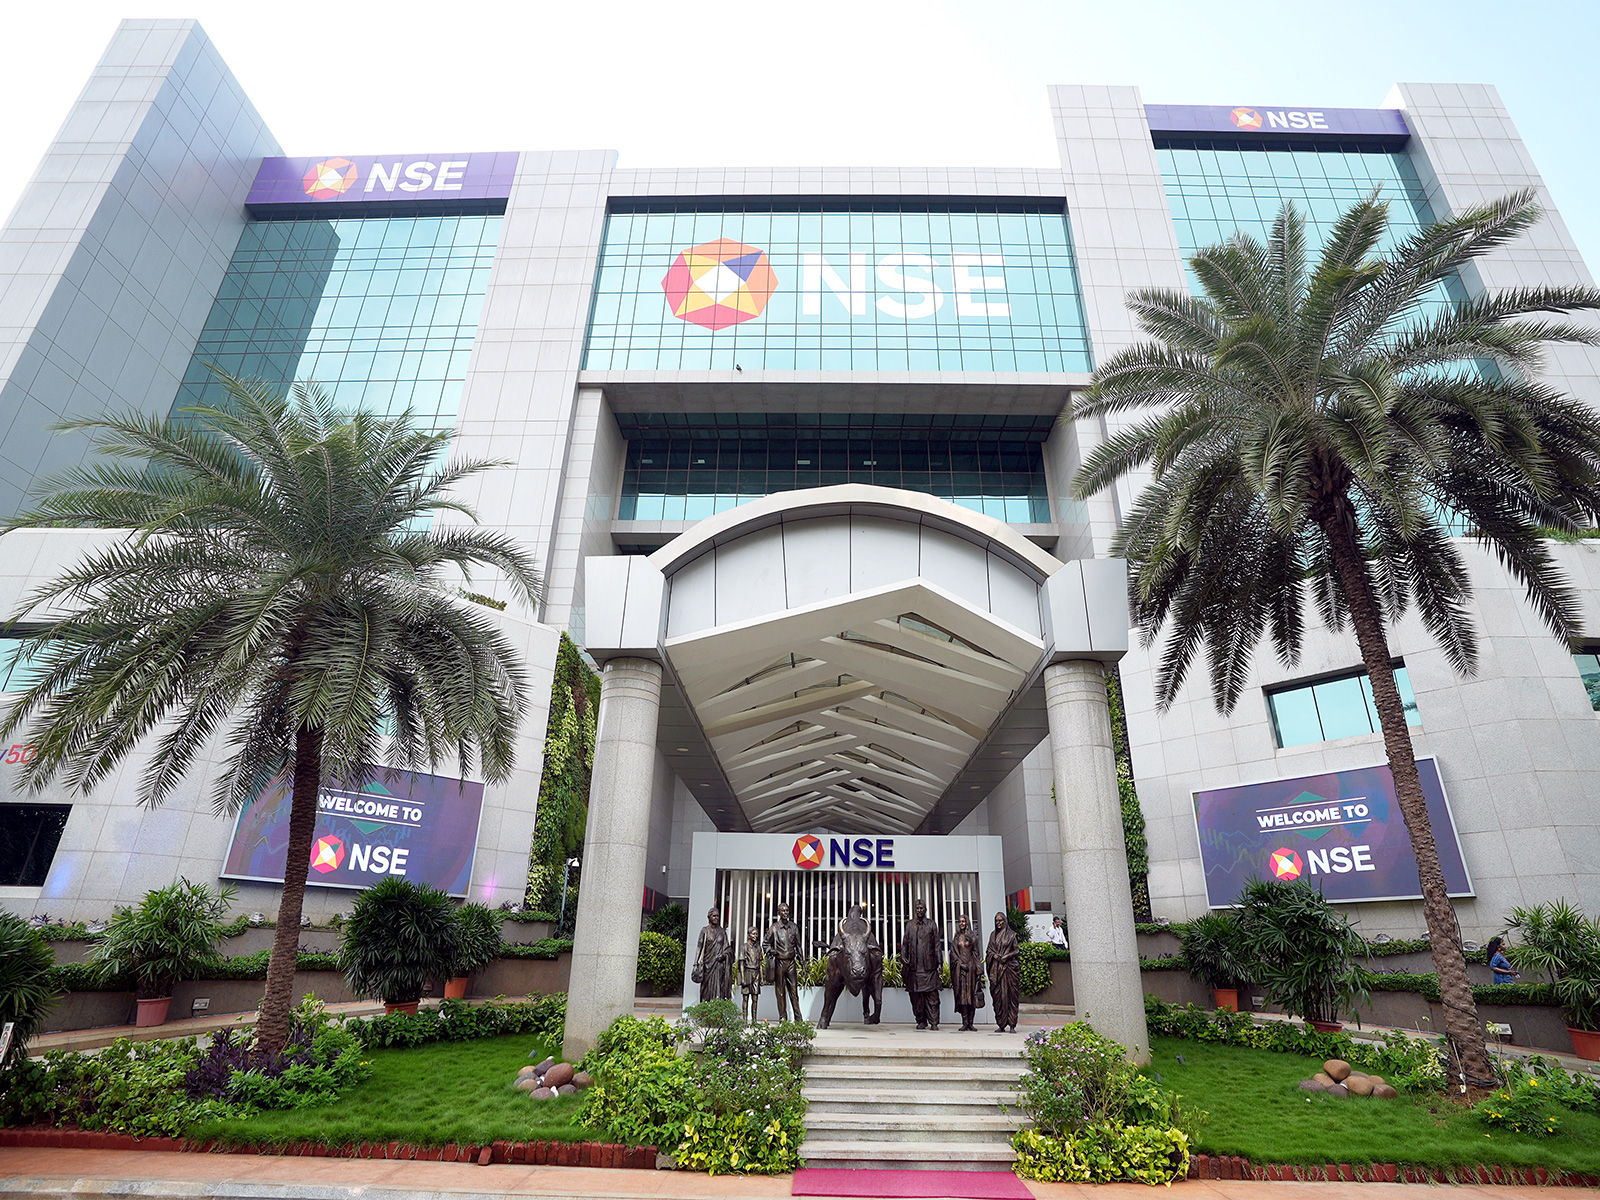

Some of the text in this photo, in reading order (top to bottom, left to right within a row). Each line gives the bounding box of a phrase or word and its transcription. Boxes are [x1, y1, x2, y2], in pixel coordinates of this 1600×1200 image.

[1266, 111, 1329, 129] NSE
[364, 161, 468, 192] NSE
[802, 252, 1012, 319] NSE
[319, 795, 422, 821] WELCOME TO
[1257, 804, 1369, 827] WELCOME TO
[348, 843, 409, 875] NSE
[830, 838, 894, 867] NSE
[1307, 845, 1375, 874] NSE
